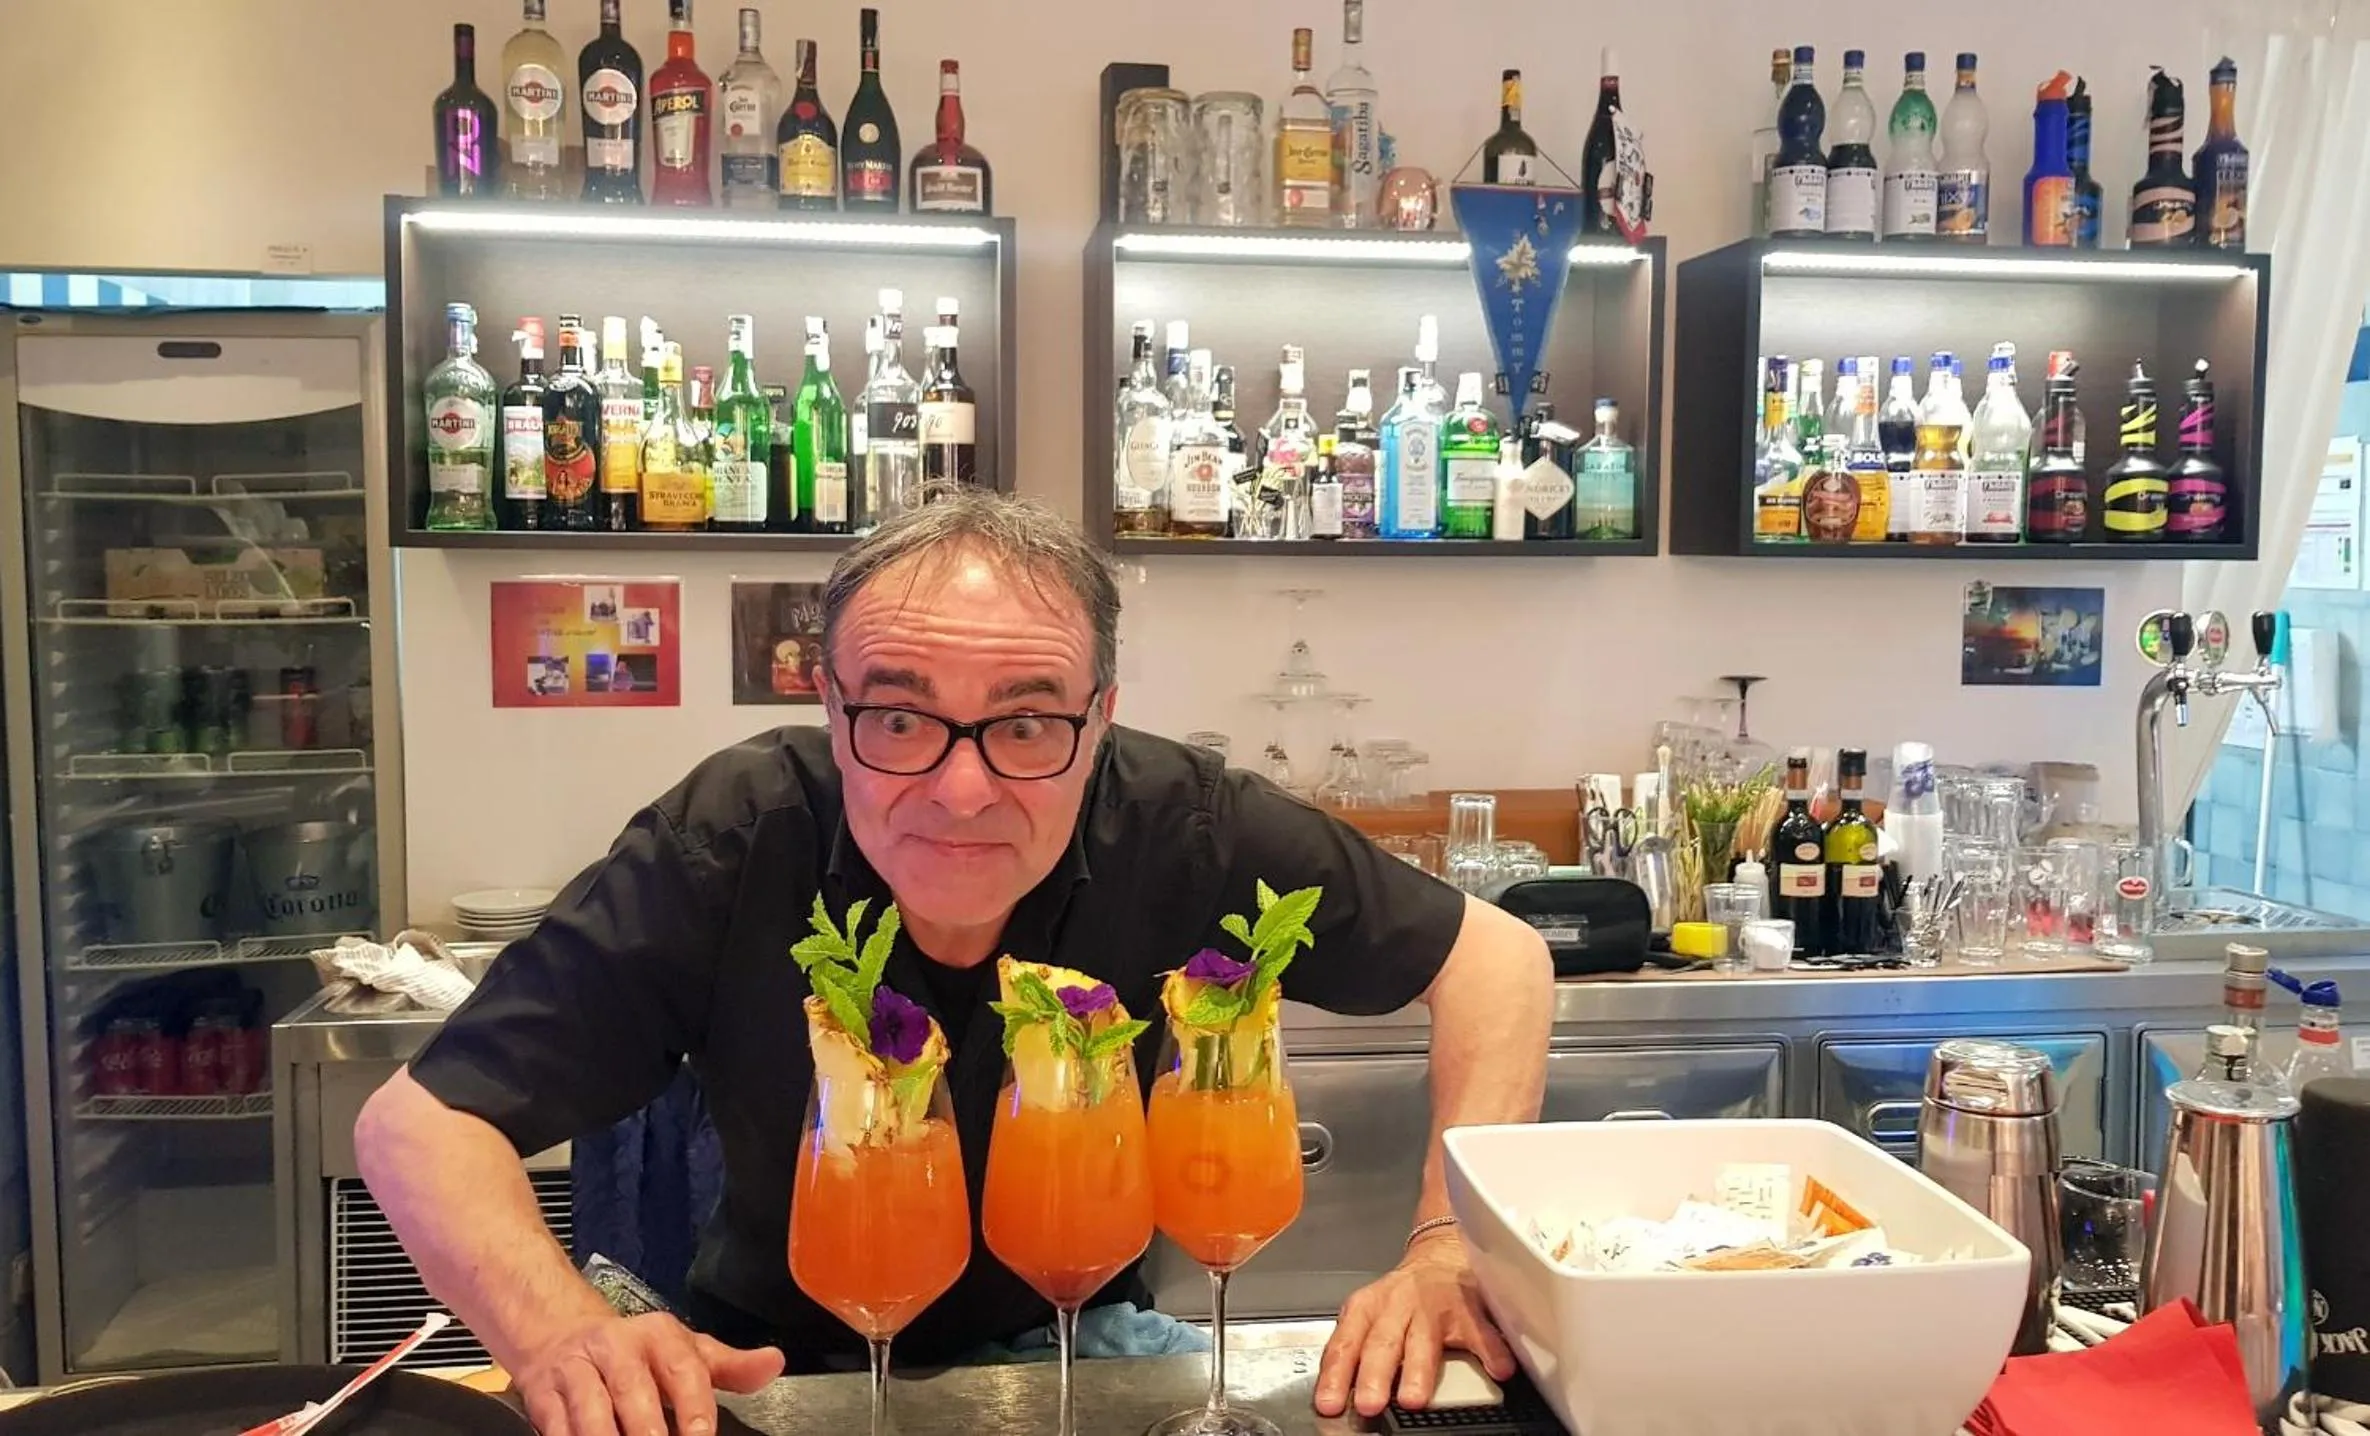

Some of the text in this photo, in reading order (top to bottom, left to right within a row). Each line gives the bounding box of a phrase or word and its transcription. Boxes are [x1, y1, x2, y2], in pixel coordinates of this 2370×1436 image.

[512, 87, 557, 99] MARTINI
[587, 91, 633, 103] MARTINI
[654, 94, 699, 114] APEROL
[1352, 101, 1373, 175] Sagatiba
[431, 418, 475, 429] MARTINI
[263, 891, 358, 920] Corona
[2319, 1327, 2369, 1354] JACK
